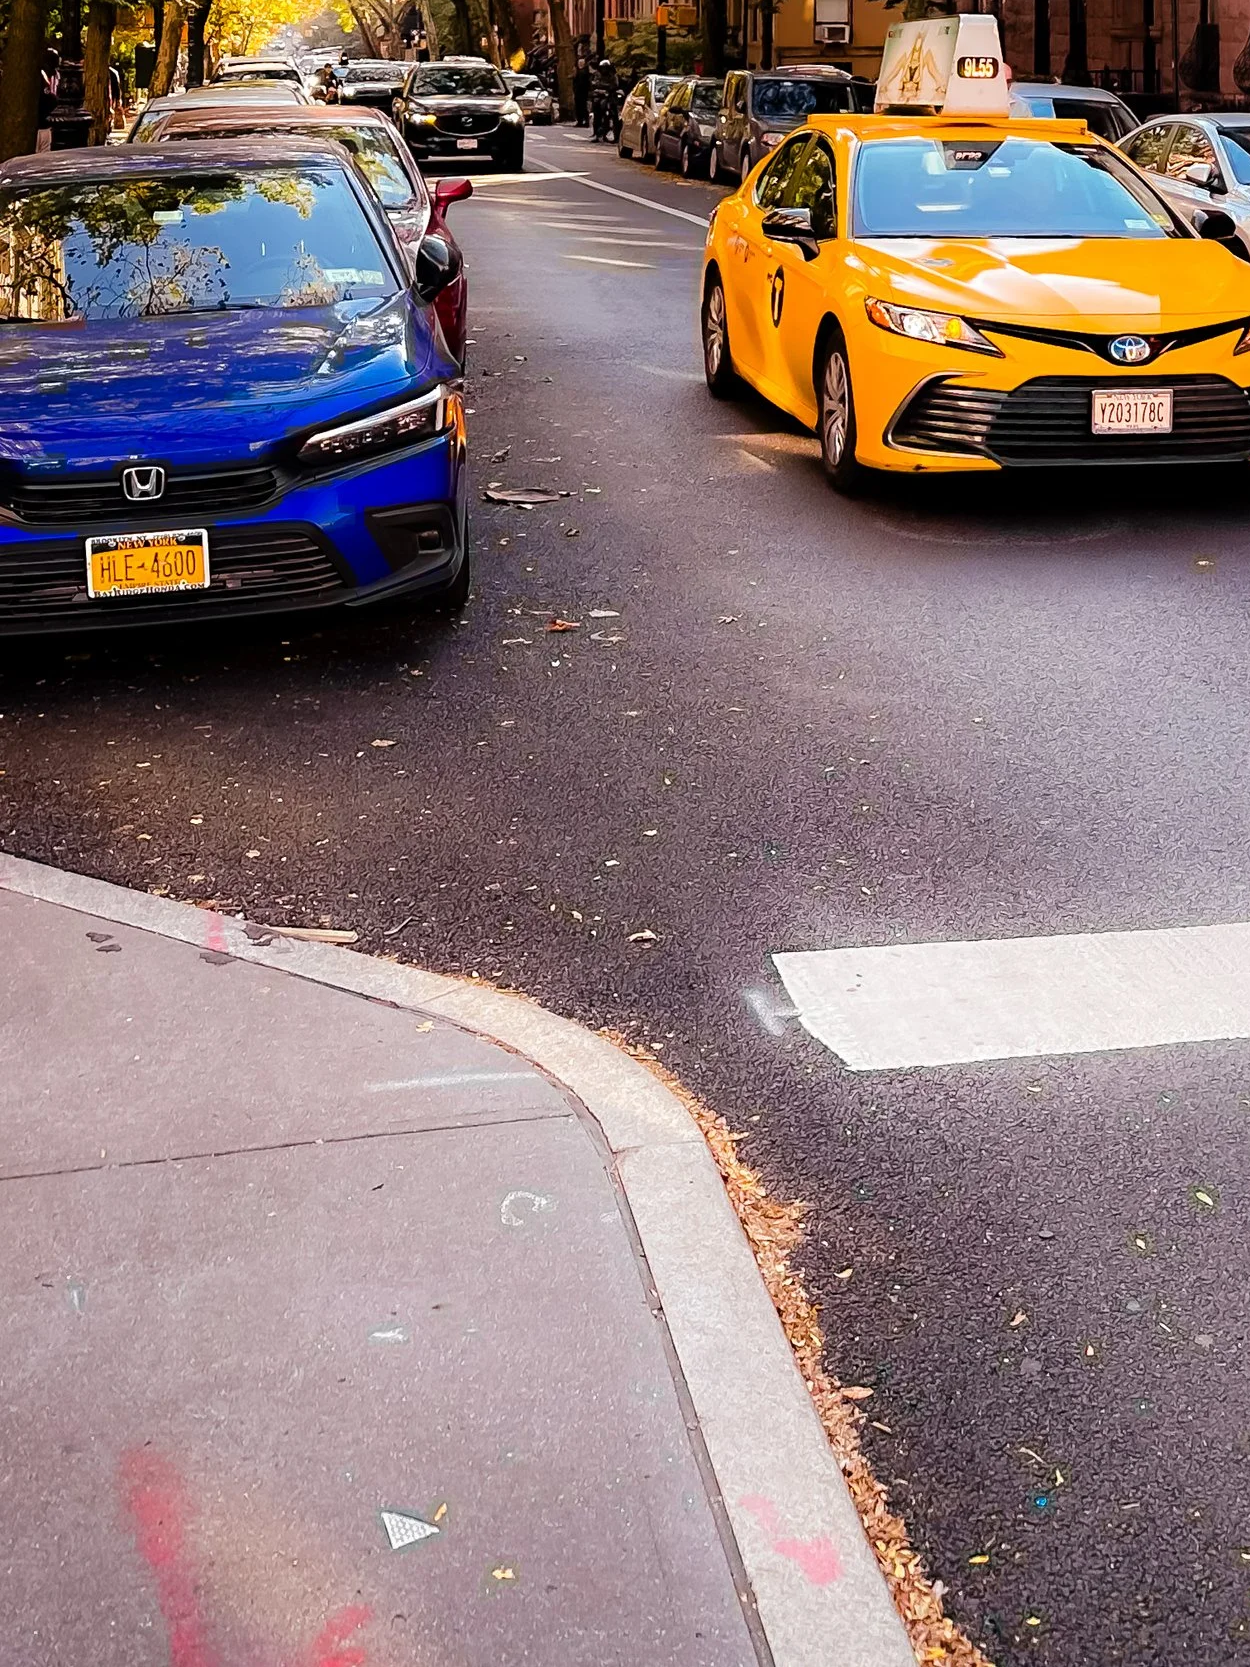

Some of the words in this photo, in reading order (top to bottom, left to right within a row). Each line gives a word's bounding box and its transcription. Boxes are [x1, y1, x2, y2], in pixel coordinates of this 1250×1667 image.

[963, 57, 995, 78] 9L55
[1100, 401, 1164, 423] Y203178C
[117, 540, 146, 550] NEW
[147, 536, 178, 548] YORK
